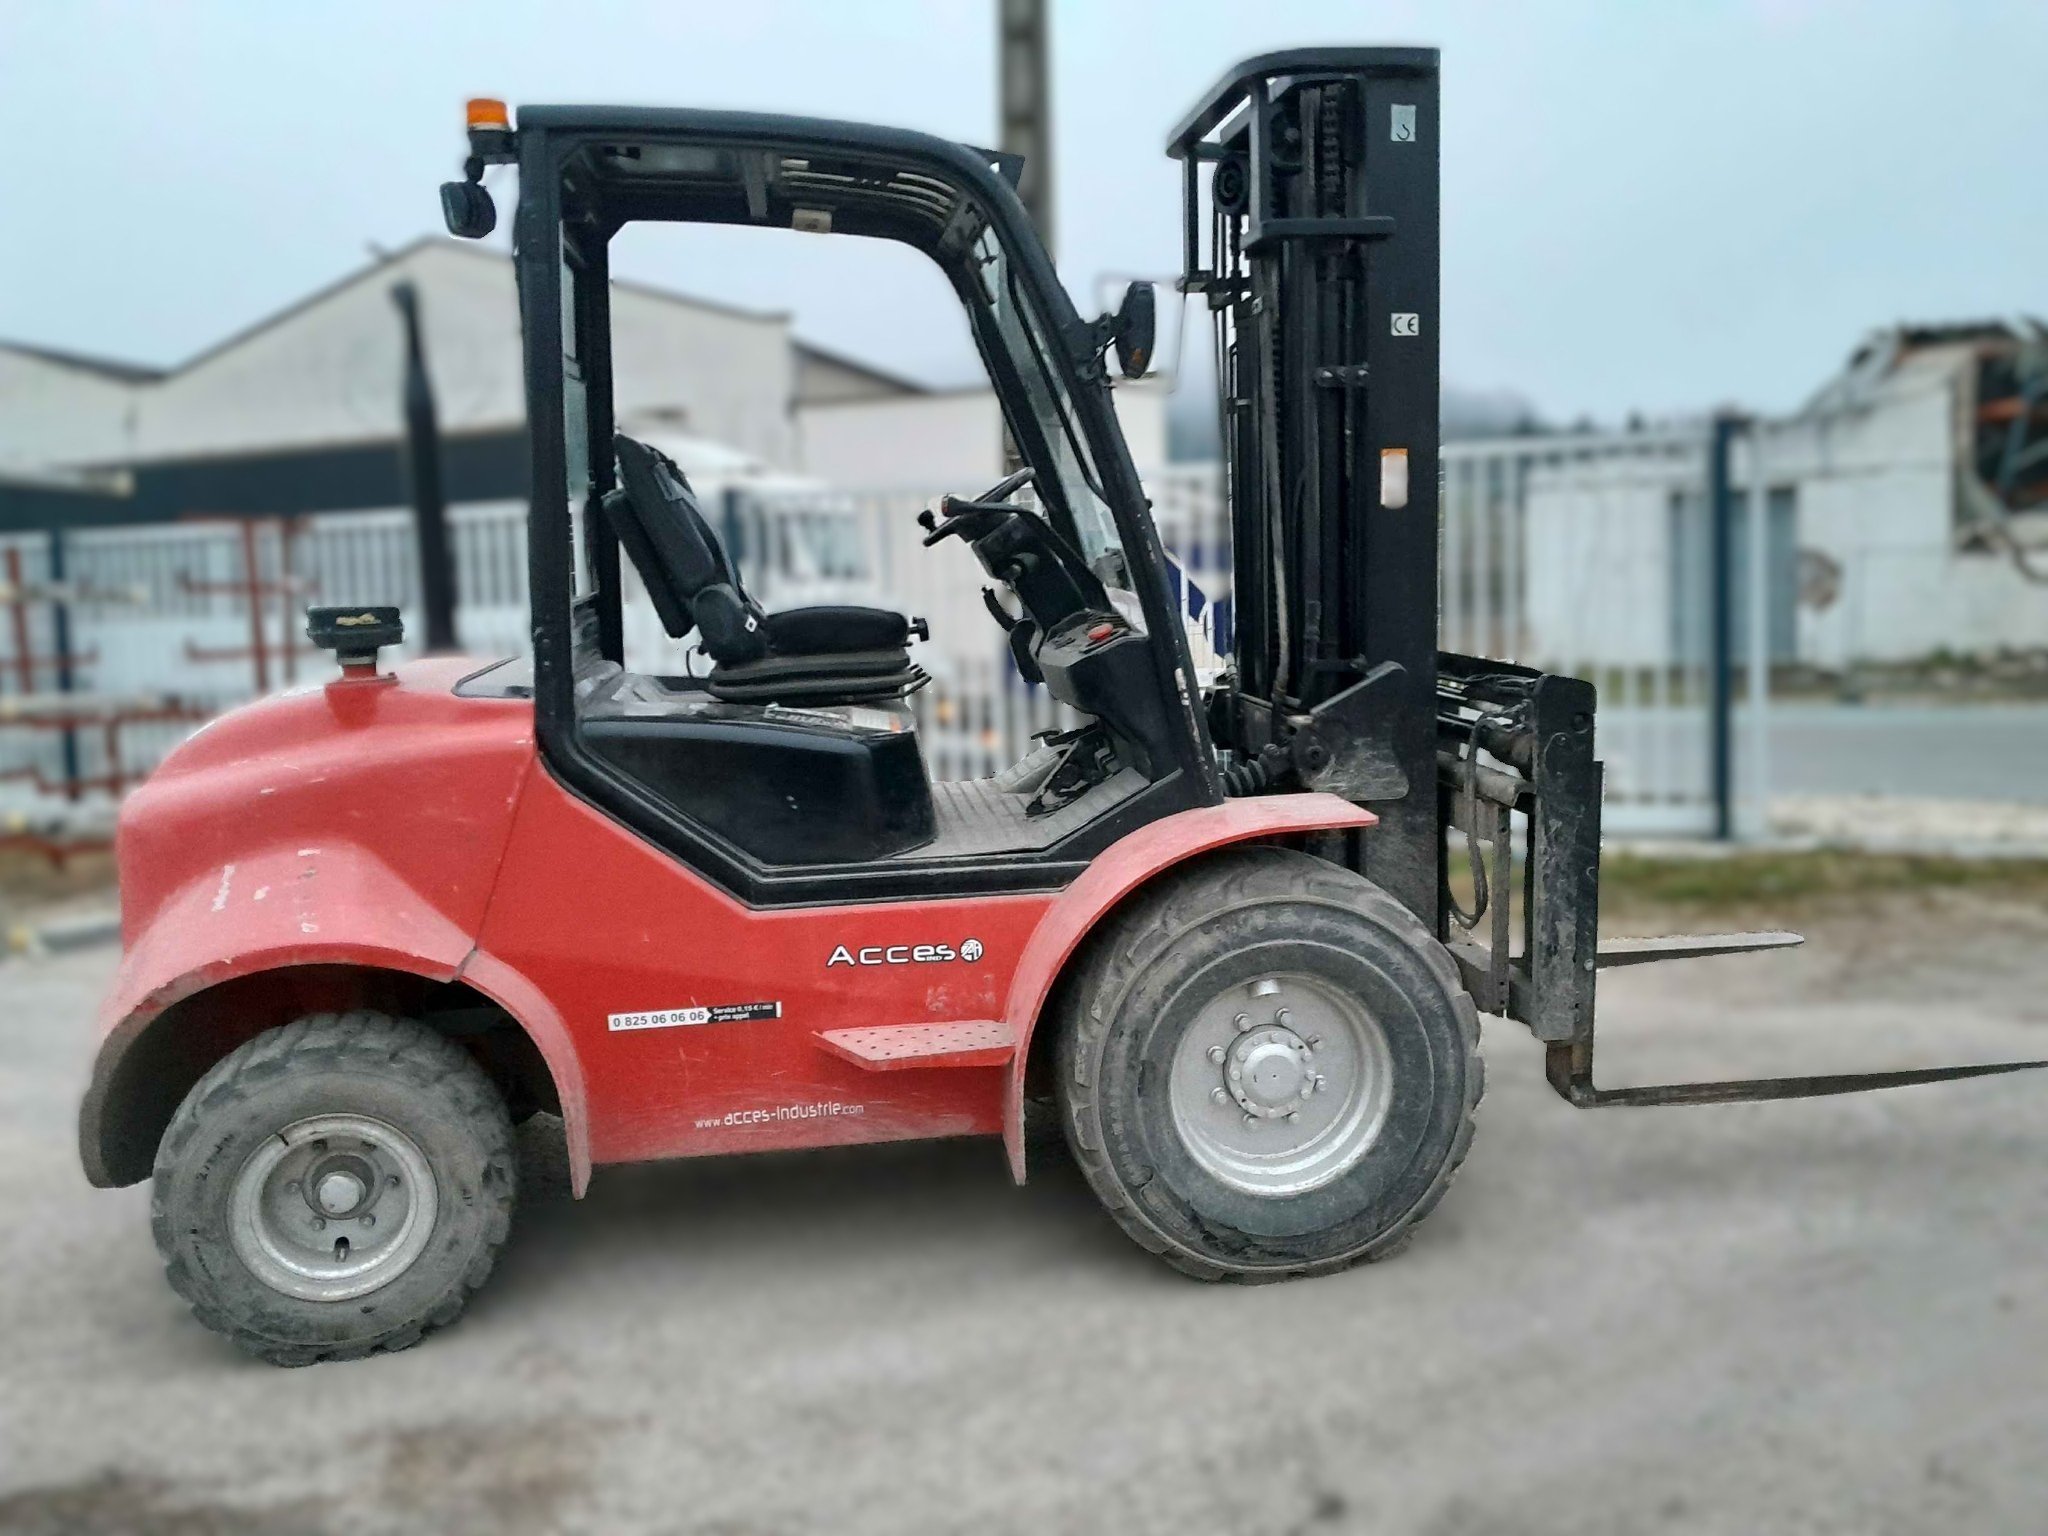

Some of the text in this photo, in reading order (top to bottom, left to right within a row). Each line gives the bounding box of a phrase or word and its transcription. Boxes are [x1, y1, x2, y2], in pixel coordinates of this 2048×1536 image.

[1394, 316, 1416, 334] CE
[827, 944, 956, 967] Acces
[613, 1011, 705, 1027] 0 825 06 06 06
